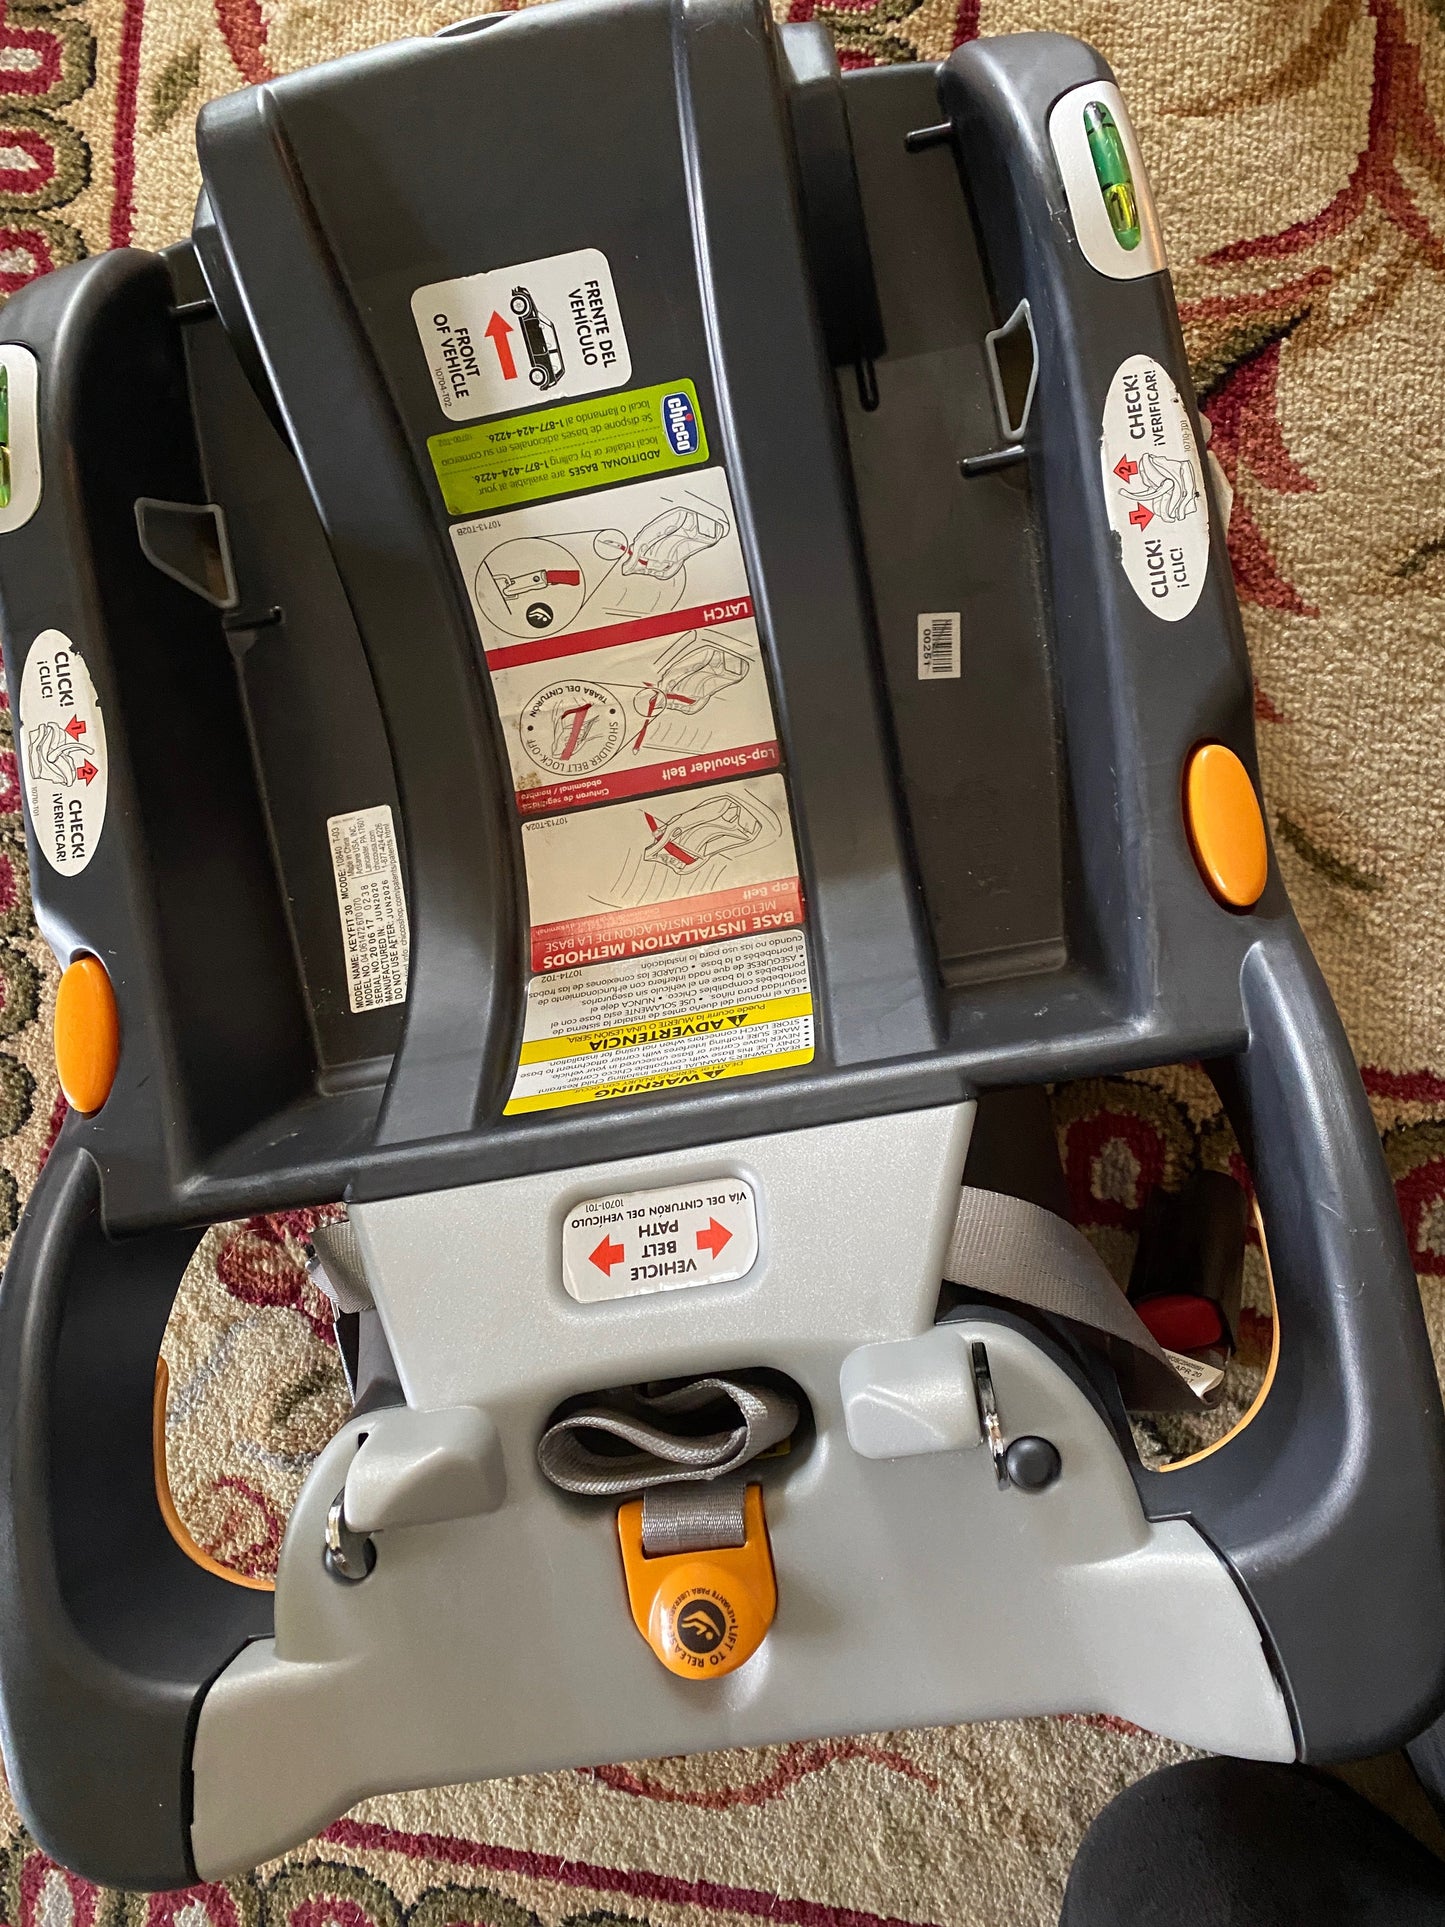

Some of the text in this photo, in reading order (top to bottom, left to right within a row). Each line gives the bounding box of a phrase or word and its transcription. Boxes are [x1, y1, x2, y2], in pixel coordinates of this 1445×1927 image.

[567, 287, 602, 367] VEHÍCULO
[584, 278, 617, 368] FRENTE DEL
[432, 312, 469, 399] OF VEHICLE
[453, 326, 480, 379] FRONT
[434, 367, 453, 407] 10704-T02
[575, 405, 619, 425] llamando
[619, 404, 627, 412] o
[627, 399, 650, 412] local
[1122, 374, 1145, 440] CHECK!
[1143, 369, 1166, 447] ¡VERIFICAR!
[485, 416, 564, 445] 1-877-424-4226.
[565, 416, 574, 426] al
[667, 397, 694, 452] chicco
[441, 412, 653, 467] Se dispone de bases adicionales en su comercio
[471, 434, 658, 486] local retailer or by calling 1-877-424-4226.
[477, 447, 661, 495] ADDITIONAL BASES are available at your
[456, 518, 501, 536] 10713-T02B
[1144, 538, 1170, 599] CLICK!
[1169, 547, 1189, 589] ¡CLIC!
[703, 600, 748, 621] LATCH
[36, 660, 52, 698] ¡CLIC!
[54, 651, 74, 707] CLICK!
[530, 685, 608, 718] TRABA DEL CINTURÓN
[526, 721, 619, 773] SHOULDER BELT LOCK-OFF
[660, 745, 775, 779] Lap-Shoulder Belt
[559, 778, 602, 793] abdominal
[563, 794, 573, 802] de
[51, 793, 67, 862] ¡VERIFICAR!
[68, 799, 86, 859] CHECK!
[525, 815, 568, 831] 10713-T02A
[741, 878, 796, 900] Lap Belt
[370, 881, 382, 922] JUN2020
[715, 899, 776, 922] MÉTODOS
[330, 826, 364, 1008] MODEL NAME: KEYFIT 30 MCODE: 10840 T-03
[365, 917, 374, 929] 17
[693, 911, 712, 925] DE
[751, 910, 794, 929] BASE
[367, 932, 376, 944] 06
[381, 878, 403, 999] DO NOT USE AFTER: JUN2026
[544, 938, 574, 952] BASE
[576, 934, 592, 946] LA
[594, 931, 610, 943] DE
[631, 919, 746, 952] INSTALLATION
[755, 941, 766, 949] no
[769, 934, 802, 947] cuando
[369, 945, 377, 958] 20
[542, 941, 625, 968] METHODS
[689, 953, 697, 961] la
[699, 949, 719, 959] para
[722, 946, 736, 955] usa
[740, 943, 753, 952] las
[361, 962, 370, 977] NO.
[370, 958, 380, 973] NO.
[378, 937, 393, 1002] MANUFACTURED
[540, 969, 582, 983] 10714-T02
[755, 968, 806, 984] portabebés
[362, 978, 374, 1006] MODEL
[372, 974, 383, 1004] SERIAL
[699, 978, 753, 994] compatibles
[590, 1005, 598, 1013] el
[598, 1001, 619, 1012] deje
[621, 995, 655, 1008] NUNCA
[737, 1003, 765, 1013] Puede
[659, 1015, 693, 1027] MUERTE
[696, 1013, 704, 1021] la
[706, 1008, 734, 1019] ocurrir
[588, 1018, 723, 1051] ADVERTENCIA
[593, 1027, 623, 1039] LESIÓN
[625, 1023, 645, 1033] UNA
[594, 1073, 699, 1098] WARNING
[571, 1191, 746, 1228] VÍA DEL CINTURÓN DEL VEHÍCULO
[585, 1198, 623, 1212] 10701-T01
[638, 1219, 678, 1238] PATH
[641, 1240, 676, 1258] BELT
[630, 1257, 697, 1280] VEHICLE
[1175, 1365, 1191, 1375] APR
[725, 1625, 739, 1652] LIFT
[709, 1651, 726, 1665] TO
